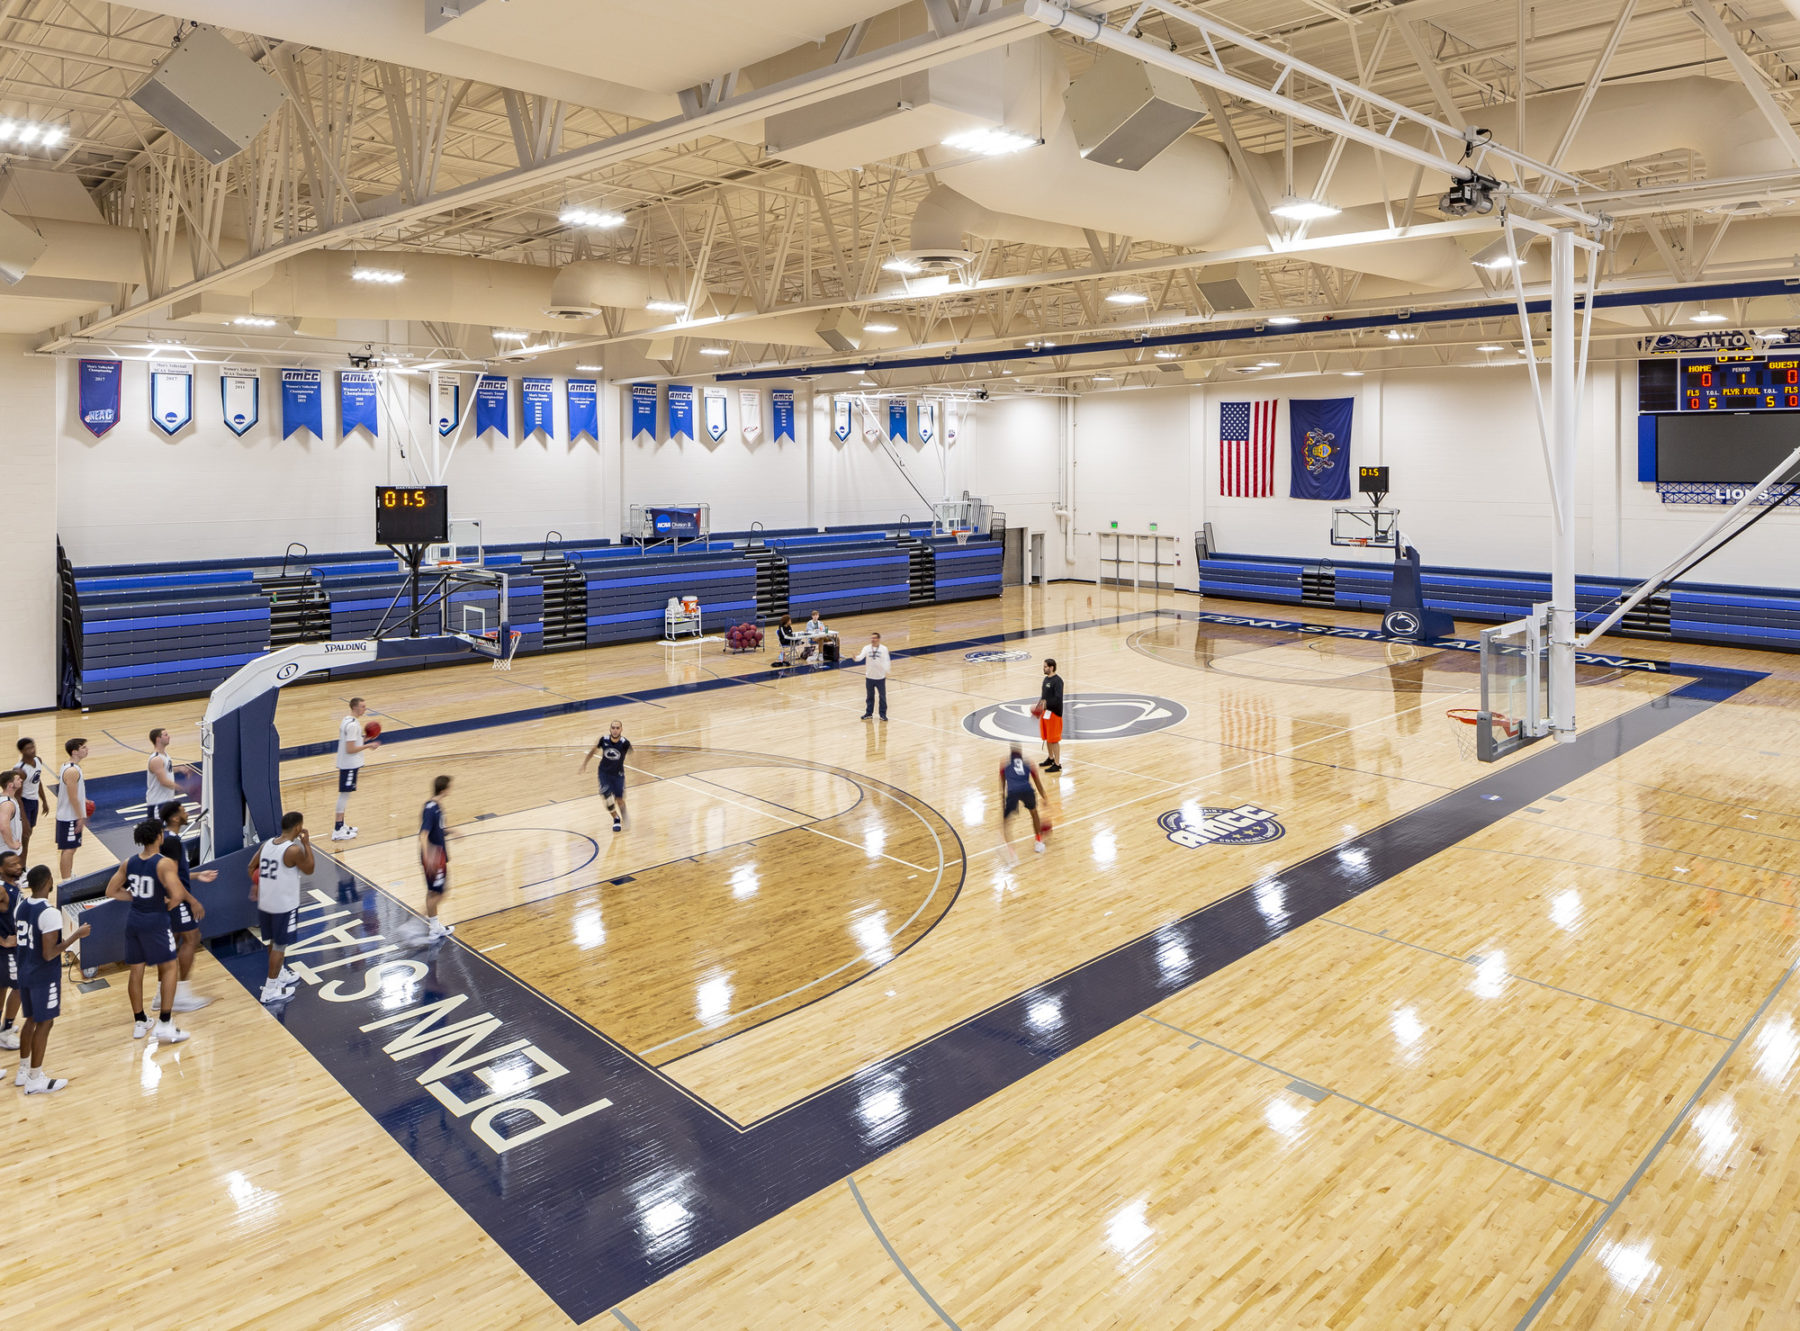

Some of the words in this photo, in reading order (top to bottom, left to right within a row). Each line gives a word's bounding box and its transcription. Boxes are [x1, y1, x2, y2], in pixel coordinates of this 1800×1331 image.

[1688, 365, 1712, 373] HOME
[1769, 361, 1799, 369] GUEST
[284, 372, 319, 381] AMCC
[1701, 373, 1712, 387] 0
[1741, 373, 1746, 383] 1
[1787, 369, 1798, 384] 0
[478, 381, 506, 389] AMCC
[524, 383, 551, 391] AMCC
[569, 384, 595, 392] AMCC
[1784, 386, 1799, 394] FLS
[633, 387, 657, 395] AMCC
[669, 392, 691, 400] AMCC
[1687, 389, 1700, 397] FLS
[1722, 388, 1740, 396] PLYR
[1743, 387, 1761, 395] FOUL
[1691, 398, 1700, 409] 0
[1708, 397, 1718, 409] 5
[1766, 396, 1775, 407] 5
[1789, 395, 1799, 407] 0
[1361, 468, 1379, 477] 01.5
[385, 491, 425, 507] 01.5
[1716, 489, 1769, 500] LIOS
[1197, 615, 1292, 629] PENN
[325, 642, 367, 653] SPALDING
[260, 858, 279, 880] 22
[128, 874, 155, 899] 30
[359, 994, 613, 1154] PENN
